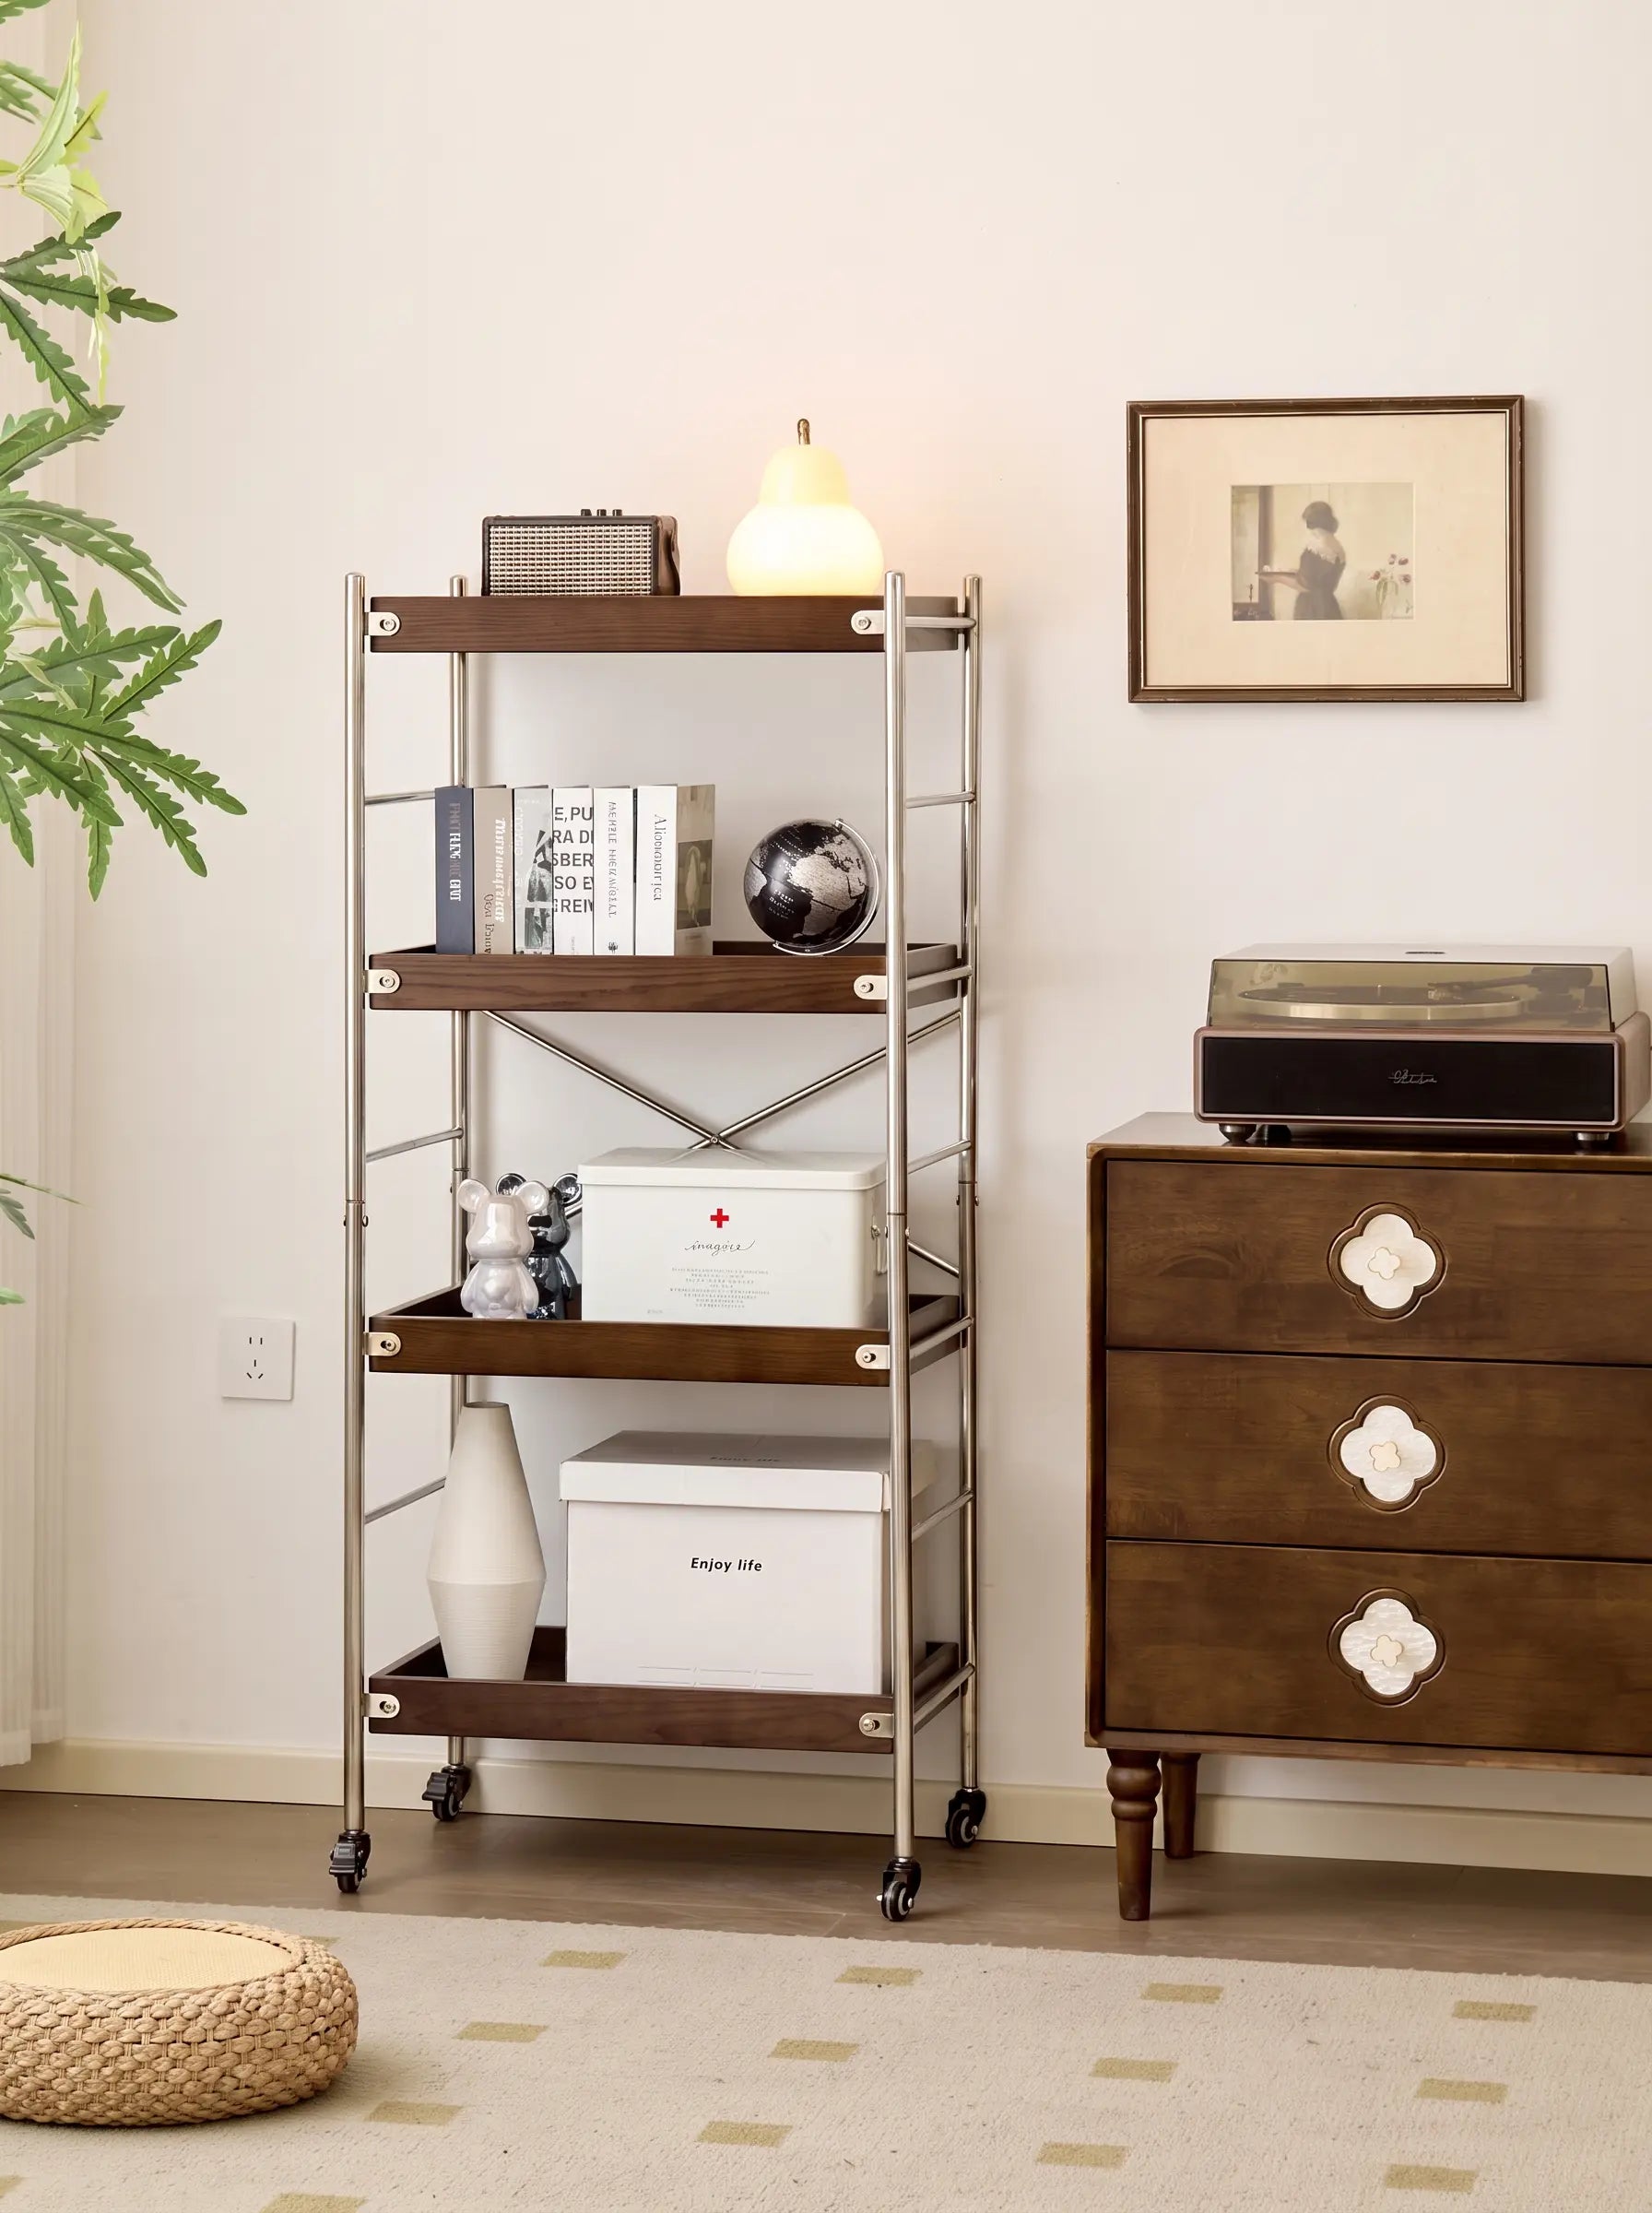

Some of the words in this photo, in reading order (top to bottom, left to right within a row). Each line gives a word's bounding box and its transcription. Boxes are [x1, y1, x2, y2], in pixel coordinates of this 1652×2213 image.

[554, 875, 577, 890] SO
[690, 1557, 733, 1573] Enjoy
[737, 1558, 762, 1571] life
